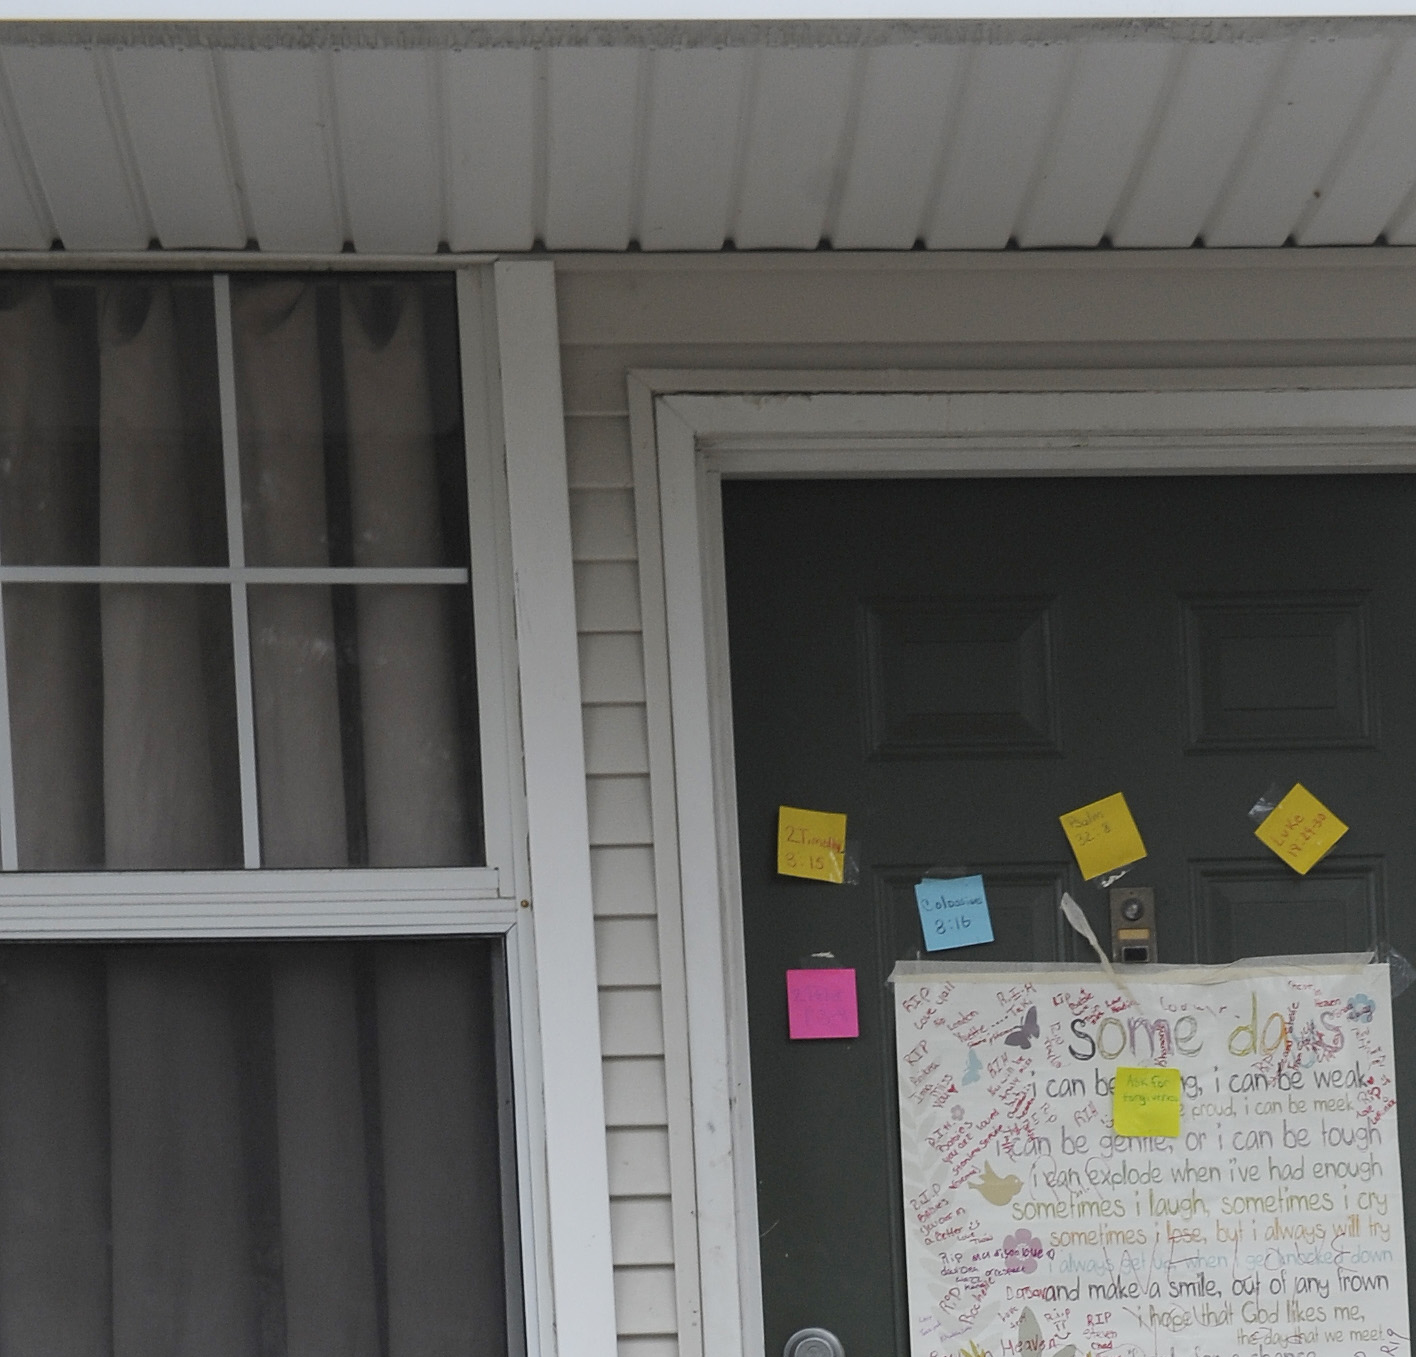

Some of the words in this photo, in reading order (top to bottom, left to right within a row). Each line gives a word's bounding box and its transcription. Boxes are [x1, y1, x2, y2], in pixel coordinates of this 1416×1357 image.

[1068, 1014, 1204, 1062] some
[1030, 1070, 1038, 1099] i
[1046, 1077, 1086, 1098] can
[1213, 1065, 1220, 1094] i
[1228, 1076, 1269, 1093] can
[1278, 1064, 1305, 1091] be
[1313, 1061, 1369, 1089] weak
[1244, 1099, 1249, 1114] i
[1254, 1102, 1284, 1115] can
[1288, 1096, 1308, 1113] be
[1314, 1096, 1354, 1113] meek
[1013, 1135, 1051, 1157] can
[1061, 1124, 1090, 1156] be
[1185, 1131, 1207, 1151] or
[1217, 1122, 1223, 1150] i
[1232, 1131, 1274, 1151] can
[1282, 1118, 1311, 1149] be
[1322, 1117, 1383, 1150] tough
[1047, 1166, 1081, 1188] can
[1089, 1159, 1163, 1192] explode
[1170, 1157, 1222, 1183] when
[1268, 1155, 1305, 1181] had
[1312, 1152, 1384, 1183] enough
[1012, 1190, 1126, 1221] sometimes
[1134, 1191, 1140, 1217] i
[1149, 1188, 1210, 1223] laugh,
[1221, 1186, 1334, 1215] sometimes
[1342, 1184, 1348, 1209] i
[1357, 1191, 1388, 1215] cry
[1050, 1223, 1147, 1247] sometimes
[1154, 1220, 1160, 1242] i
[1166, 1220, 1206, 1244] lose,
[1216, 1219, 1242, 1243] but
[1251, 1219, 1257, 1241] i
[1264, 1218, 1326, 1246] always
[1332, 1214, 1360, 1238] will
[1368, 1214, 1391, 1242] try
[1043, 1275, 1081, 1302] and
[1088, 1270, 1141, 1300] make
[1149, 1280, 1162, 1298] a
[1169, 1270, 1222, 1298] smile,
[1231, 1270, 1261, 1296] out
[1268, 1269, 1288, 1296] of
[1295, 1275, 1330, 1299] any
[1337, 1267, 1390, 1293] frown
[1200, 1300, 1234, 1326] that
[1241, 1300, 1279, 1325] God
[1286, 1299, 1327, 1323] likes
[1333, 1303, 1366, 1323] me,
[1324, 1330, 1346, 1344] we
